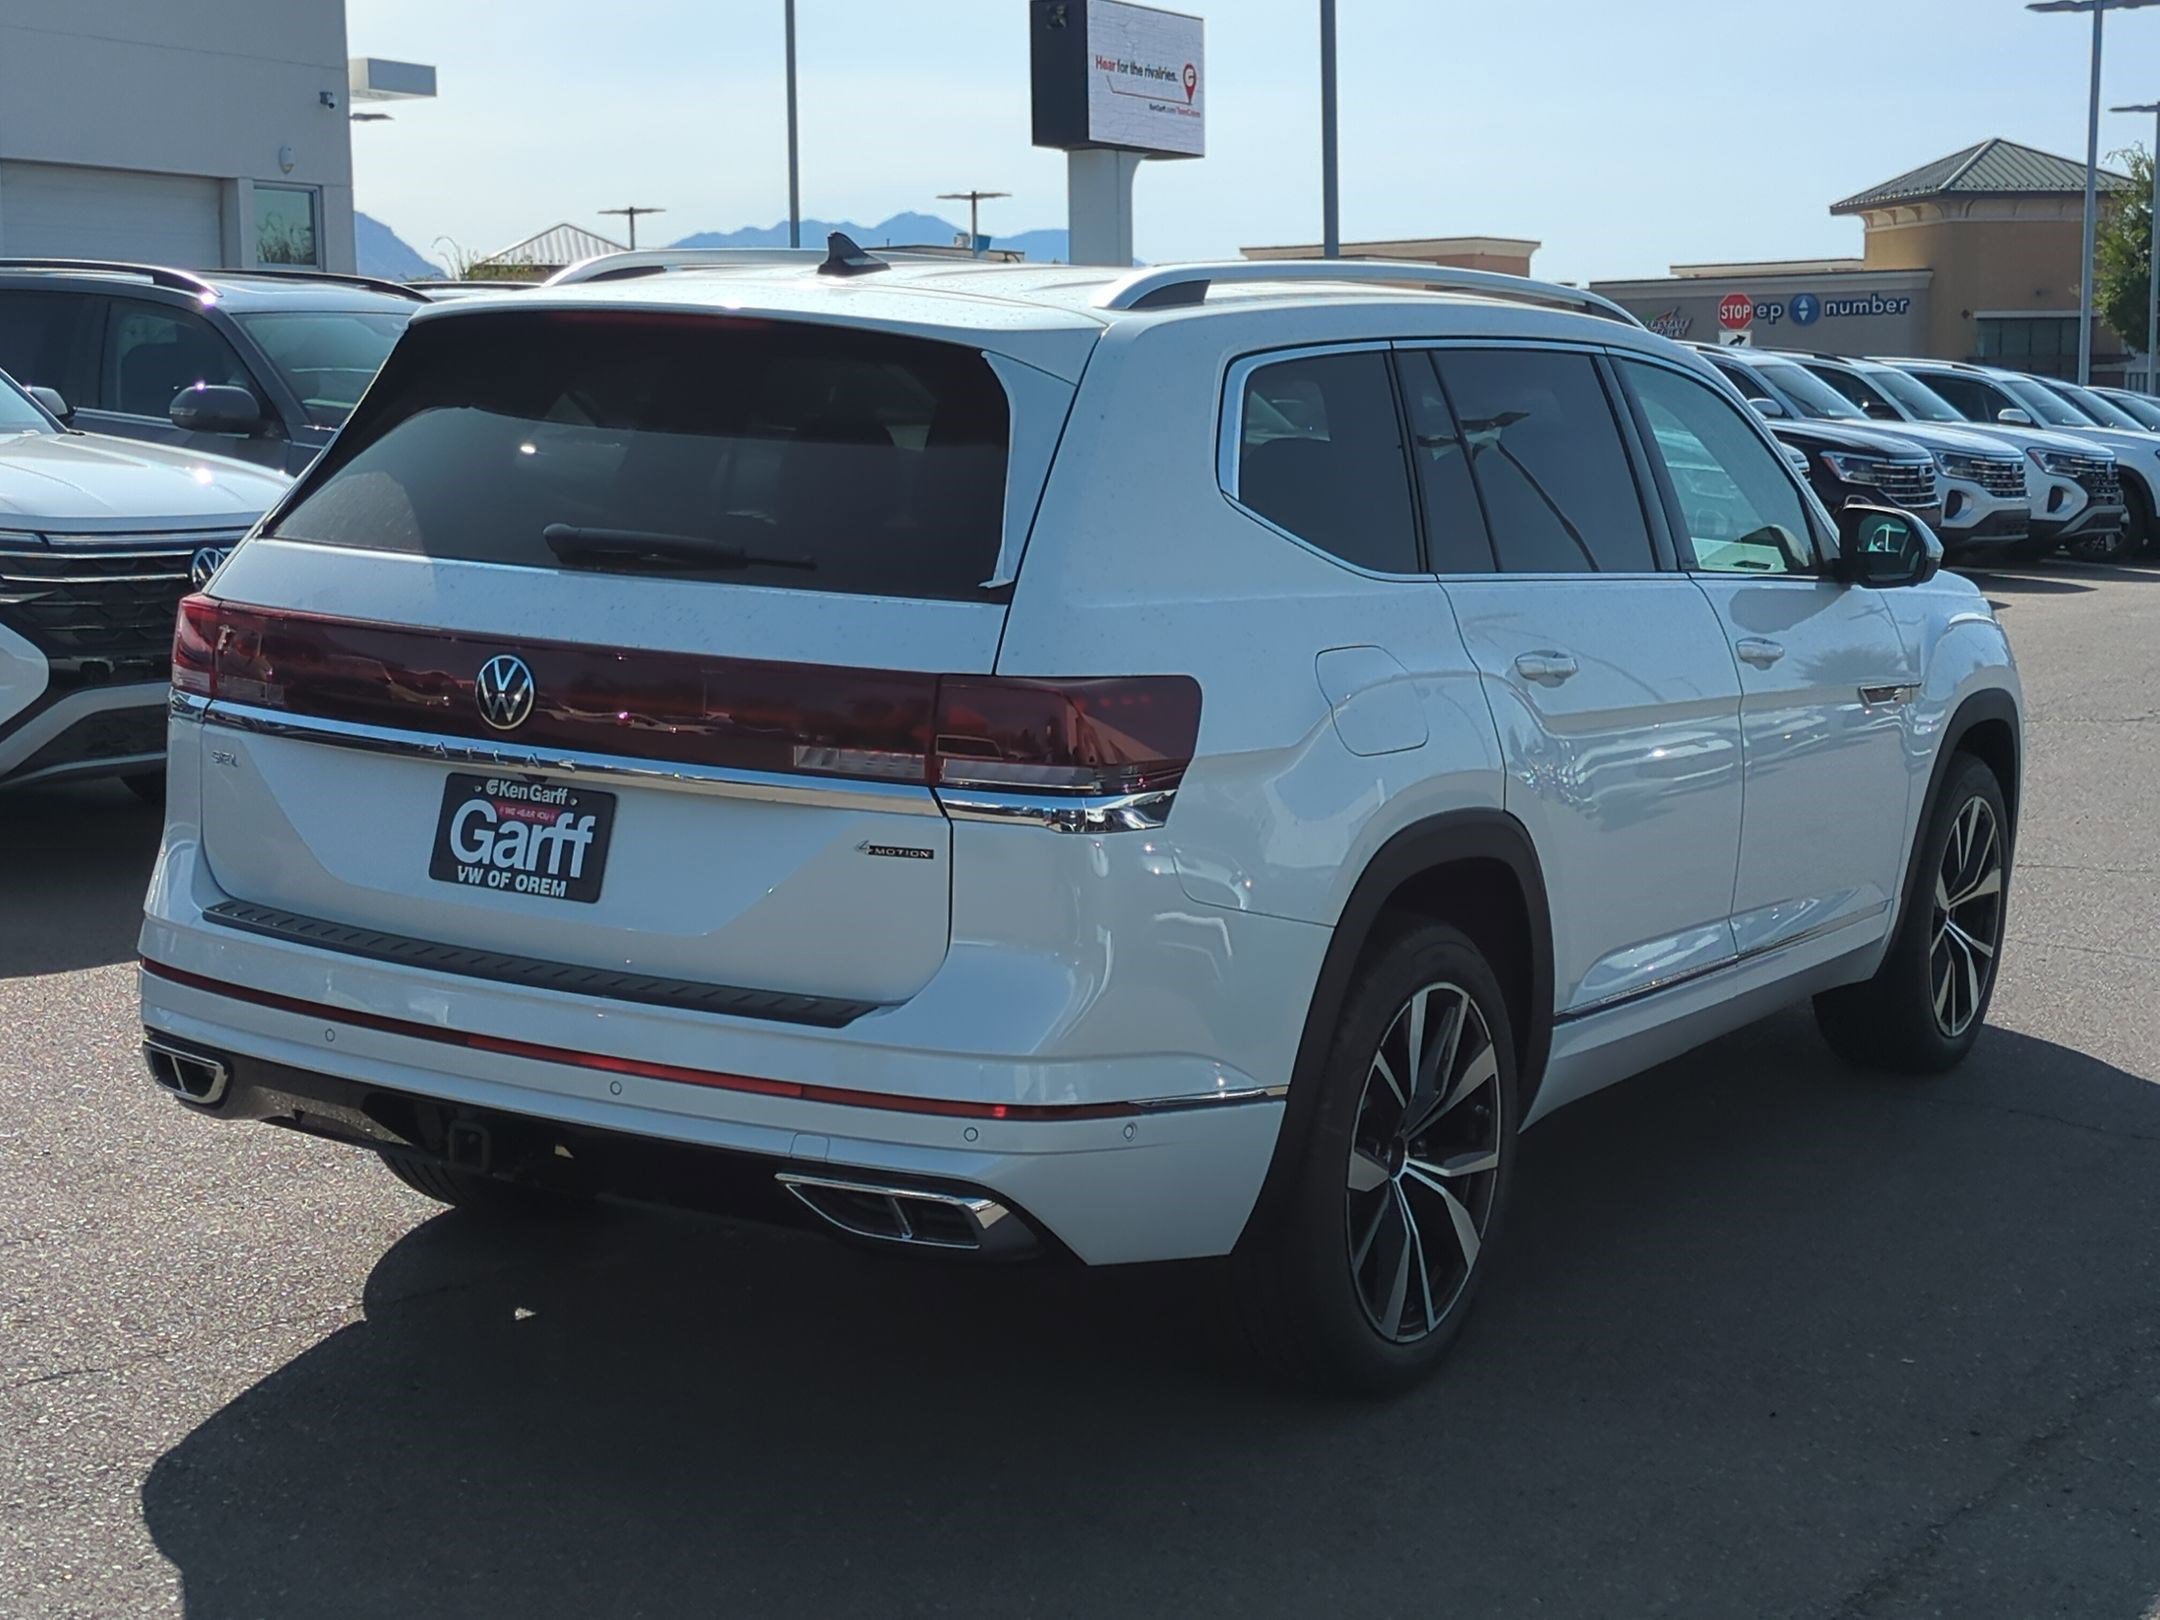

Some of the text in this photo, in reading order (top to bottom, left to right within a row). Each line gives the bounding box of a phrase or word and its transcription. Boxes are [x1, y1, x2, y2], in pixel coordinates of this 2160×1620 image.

[1095, 55, 1116, 71] Hear
[1117, 58, 1128, 74] for
[1130, 61, 1143, 77] the
[1720, 304, 1750, 320] STOP
[1826, 293, 1910, 316] number
[499, 780, 527, 800] Ken
[529, 784, 568, 805] Garff
[450, 799, 596, 878] Garff
[457, 866, 566, 897] VW OF OREM
